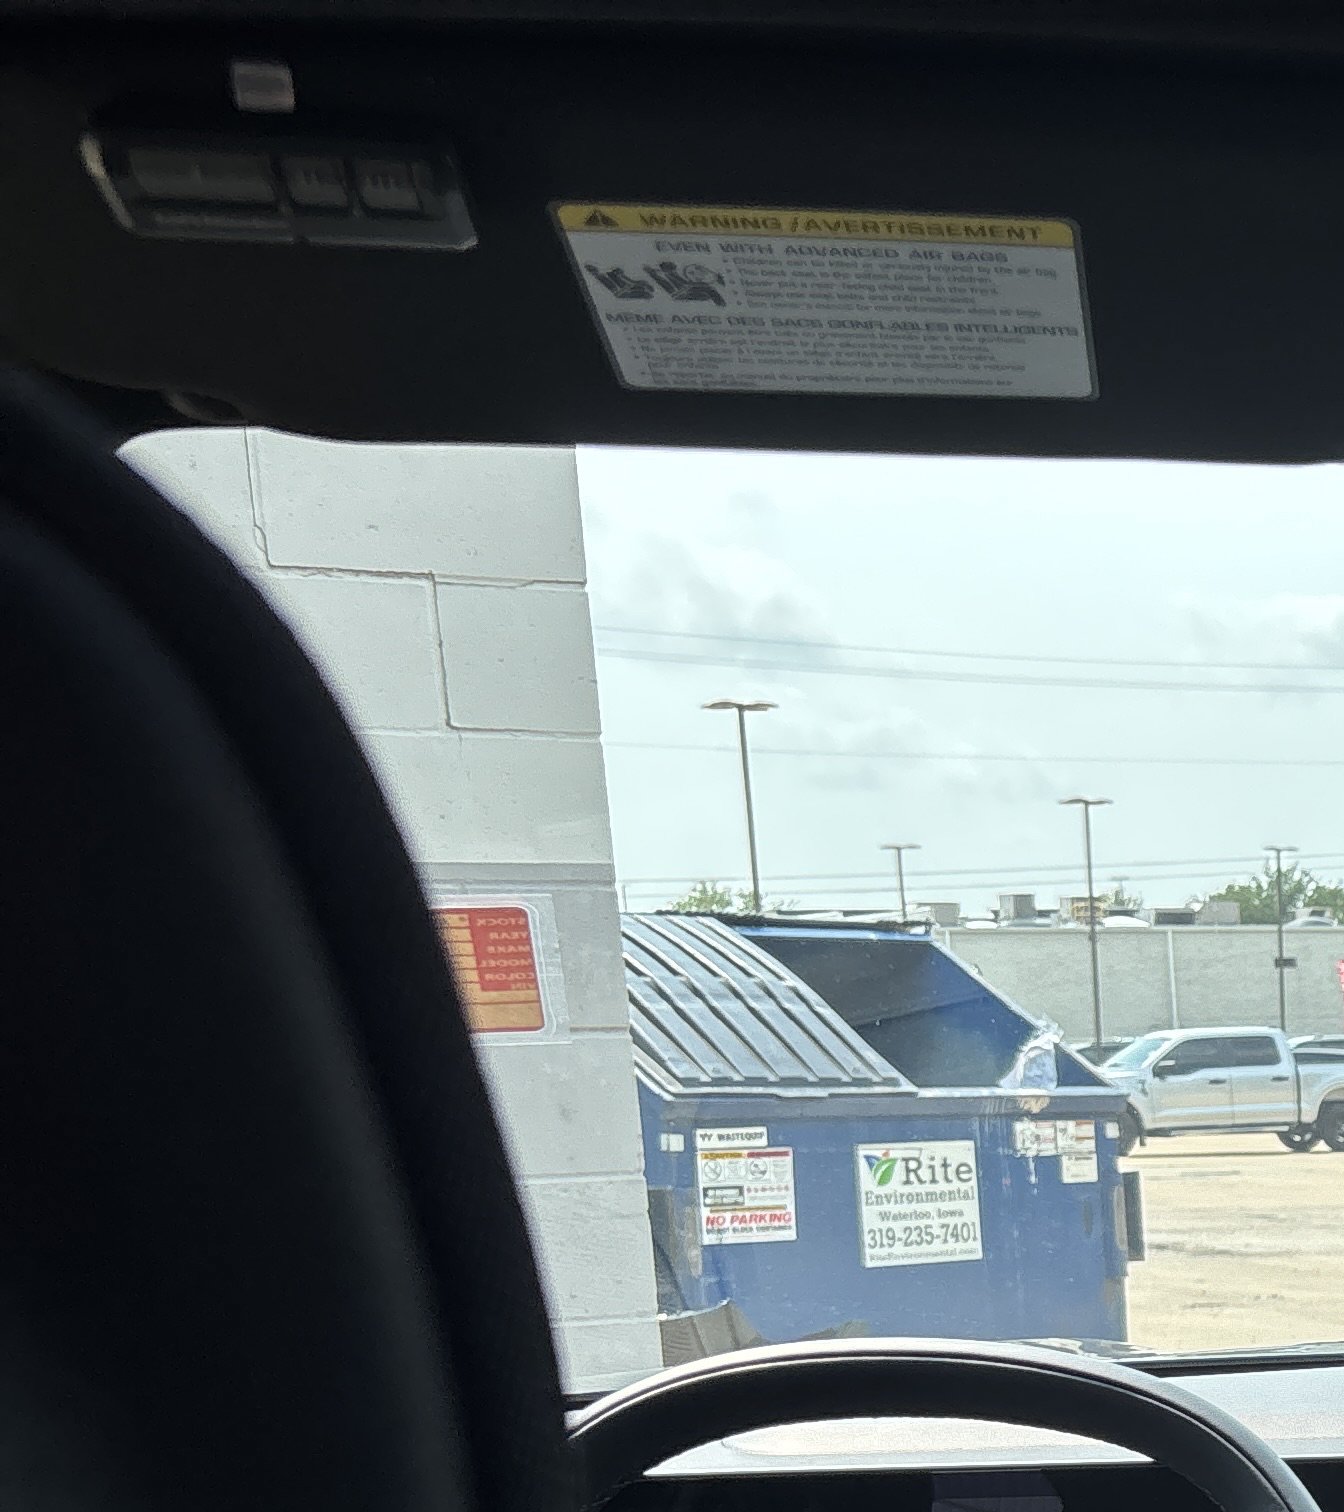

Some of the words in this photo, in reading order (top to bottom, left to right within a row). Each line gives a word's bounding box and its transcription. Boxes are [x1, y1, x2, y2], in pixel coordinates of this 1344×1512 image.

[655, 240, 711, 254] EVEN
[718, 242, 773, 255] WITH
[785, 244, 900, 259] ADVANCED
[951, 251, 1009, 263] BAGS
[671, 314, 722, 326] AVEC
[901, 1156, 973, 1186] Rite
[865, 1186, 976, 1207] Environmental
[706, 1215, 726, 1227] NO
[730, 1211, 792, 1226] PARKING
[878, 1209, 935, 1222] Waterloo,
[937, 1208, 965, 1219] Iowa
[867, 1222, 978, 1249] 319-235-7401
